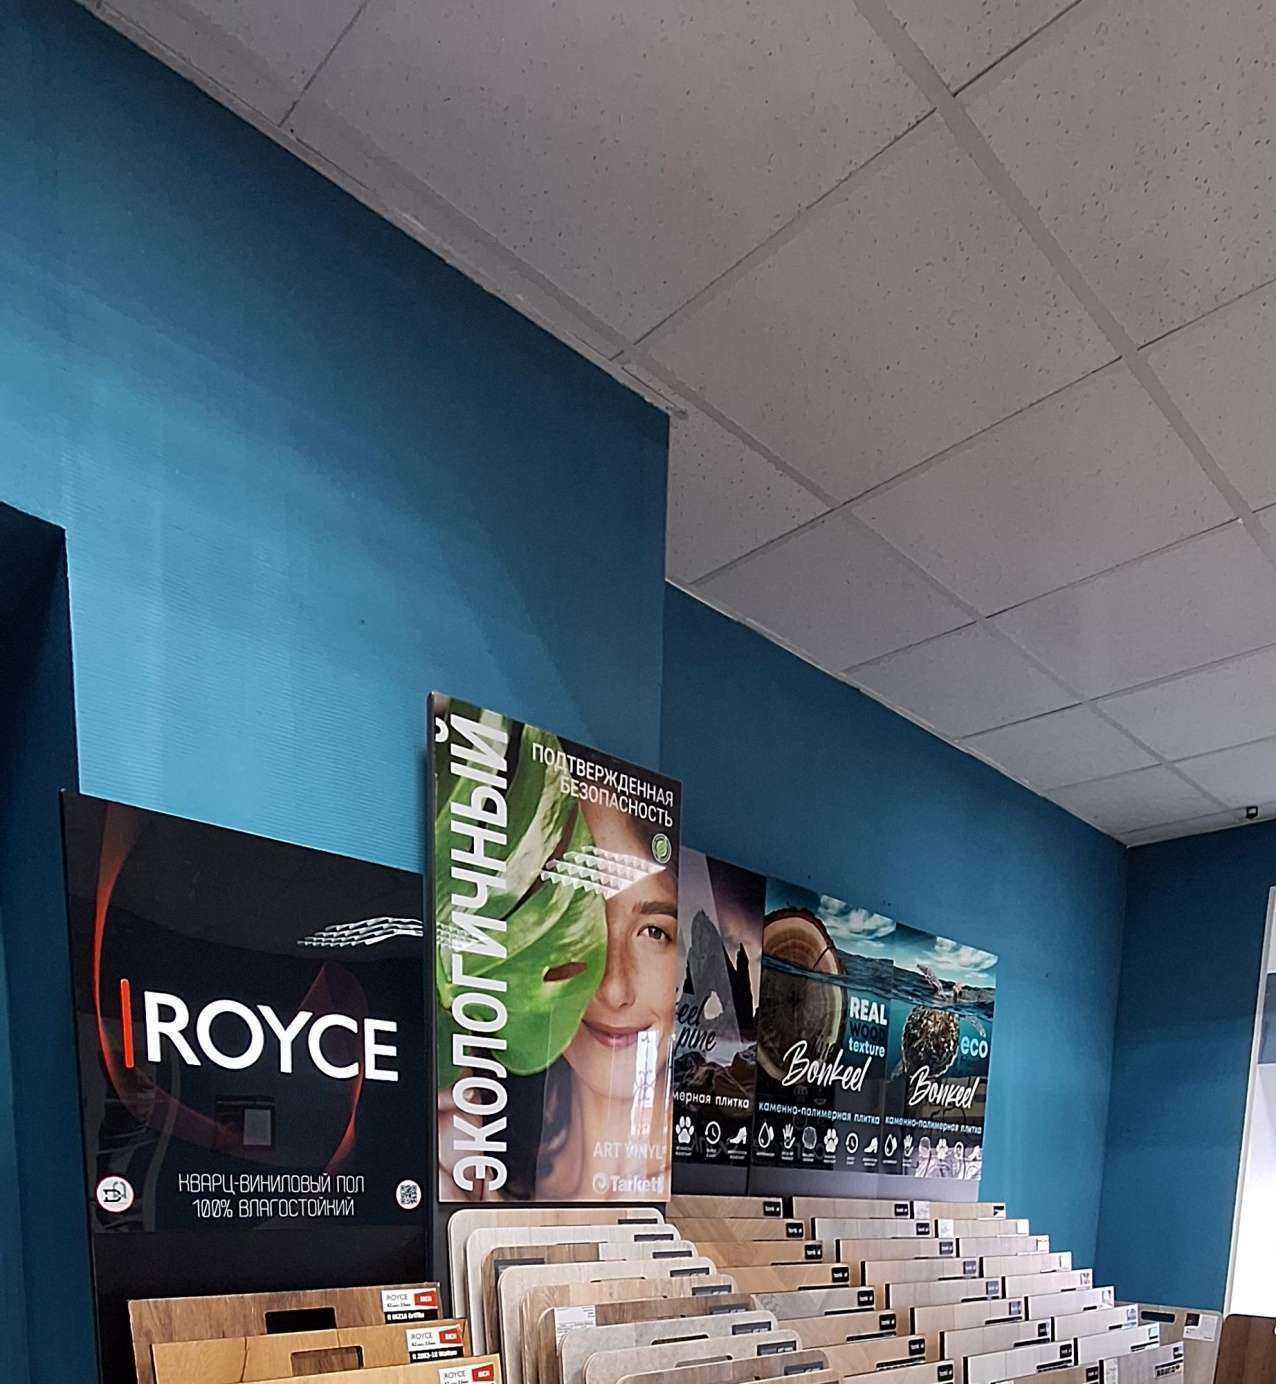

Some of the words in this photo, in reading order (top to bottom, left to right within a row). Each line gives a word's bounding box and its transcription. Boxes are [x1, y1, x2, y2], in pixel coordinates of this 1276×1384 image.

[532, 742, 674, 808] ПОДТВЕРЖДЕННАЯ
[560, 776, 674, 828] БЕЗОПАСНОСТЬ
[434, 713, 510, 1192] ЭКОЛОГИЧНЫЙ
[849, 997, 889, 1026] REAL
[143, 990, 399, 1082] ROYCE
[960, 1036, 989, 1059] eco
[848, 1039, 886, 1059] texture
[715, 1095, 750, 1109] плитка
[758, 1102, 851, 1123] каменно-полимерная
[853, 1114, 881, 1126] плитка
[885, 1116, 959, 1133] каменно-полимерная
[960, 1125, 982, 1136] плитка
[593, 1141, 621, 1159] ART
[178, 1173, 331, 1196] КВАРЦ-ВИНИЛОВЫЙ
[336, 1174, 365, 1194] ПОЛ
[192, 1199, 233, 1218] 100%
